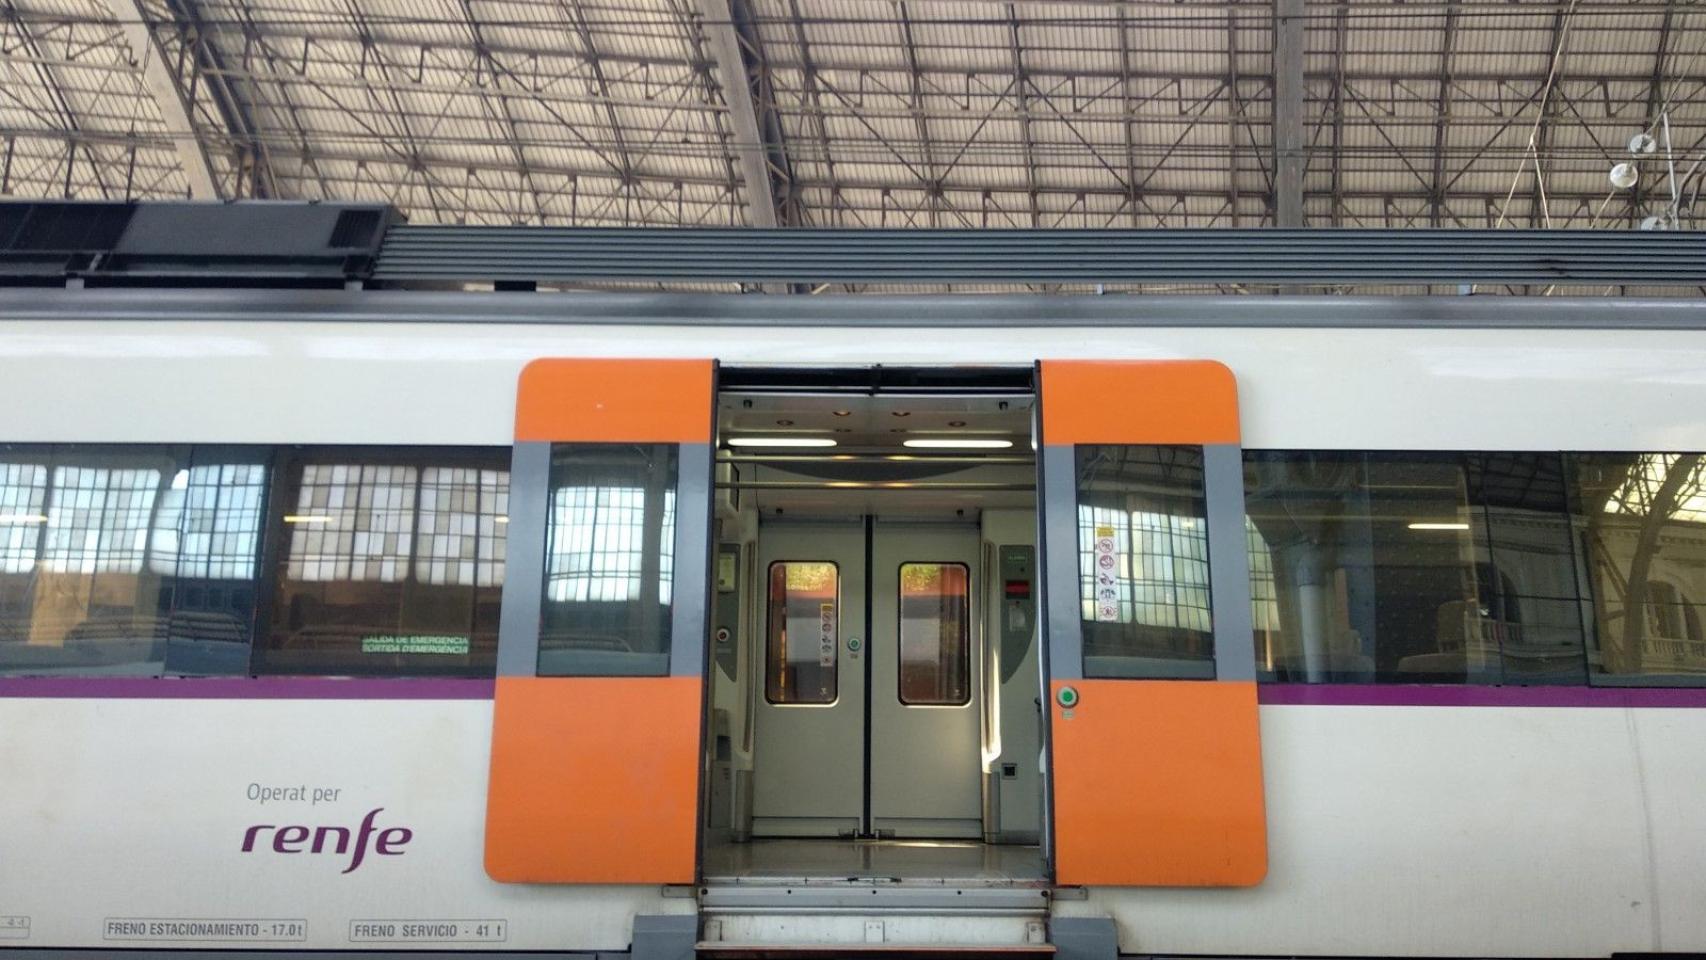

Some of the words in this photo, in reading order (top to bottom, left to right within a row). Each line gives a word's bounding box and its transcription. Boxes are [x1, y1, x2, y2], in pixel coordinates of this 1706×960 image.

[247, 782, 306, 805] Operat
[312, 786, 342, 806] per
[240, 807, 413, 874] renfe
[108, 922, 146, 936] FRENO
[149, 922, 259, 937] ESTACIONAMIENTO
[355, 924, 395, 938] FRENO
[401, 924, 457, 938] SERVICIO
[475, 925, 489, 938] 41
